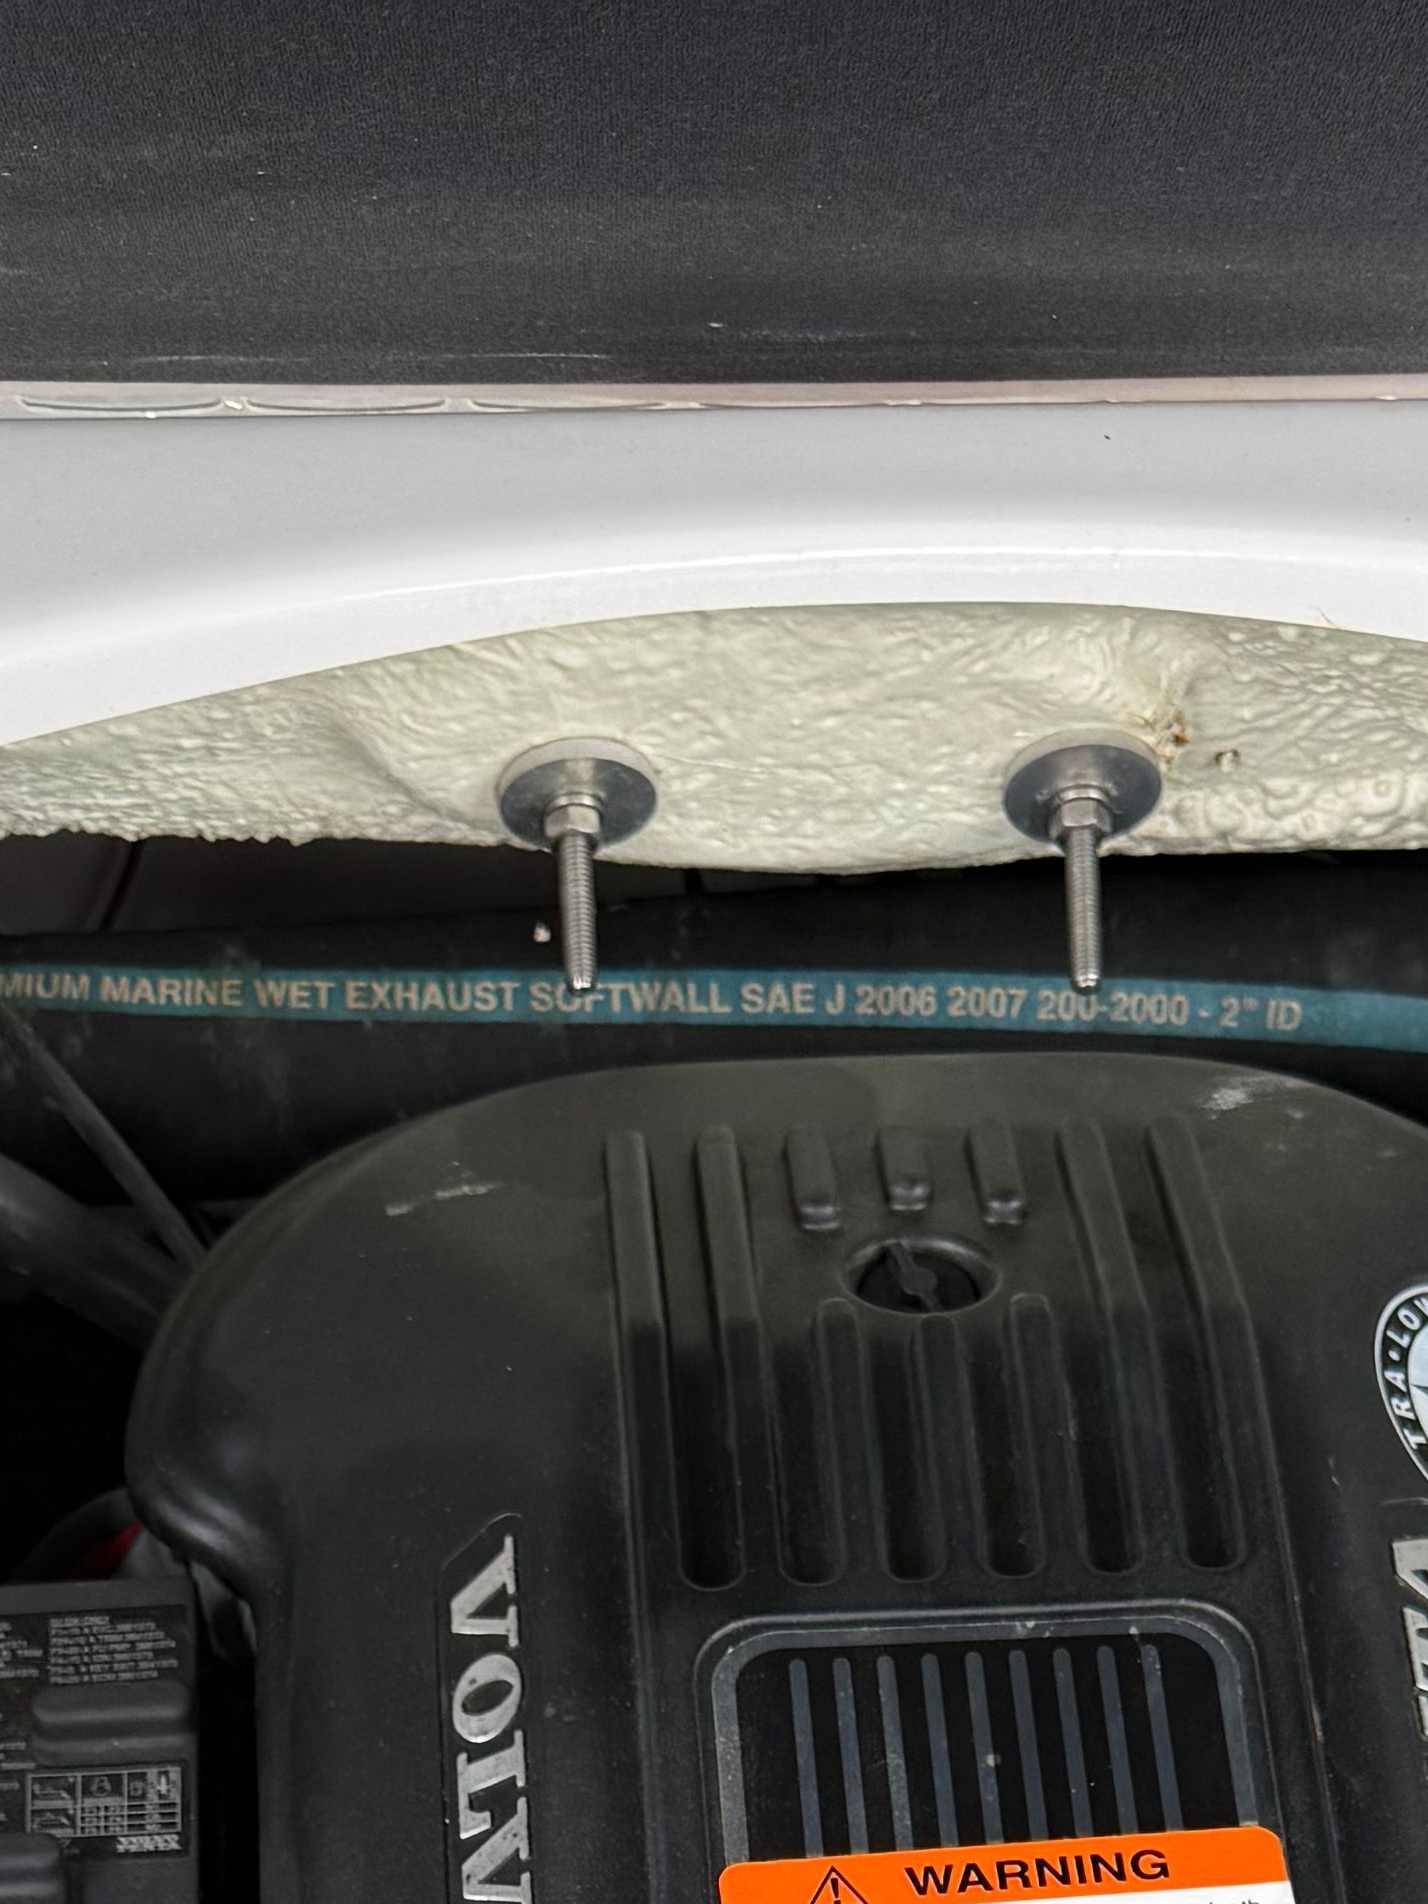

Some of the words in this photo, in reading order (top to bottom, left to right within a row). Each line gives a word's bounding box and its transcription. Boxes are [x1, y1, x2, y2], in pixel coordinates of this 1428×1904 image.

[99, 974, 244, 1007] MARINE
[253, 978, 332, 1011] WET
[345, 980, 520, 1014] EXHAUST
[529, 980, 733, 1015] SOFTWALL
[739, 981, 816, 1016] SAE
[824, 983, 845, 1016] J
[853, 984, 938, 1018] 2006
[946, 987, 1026, 1020] 2007
[1266, 999, 1303, 1031] ID
[904, 1849, 1171, 1897] WARNING
